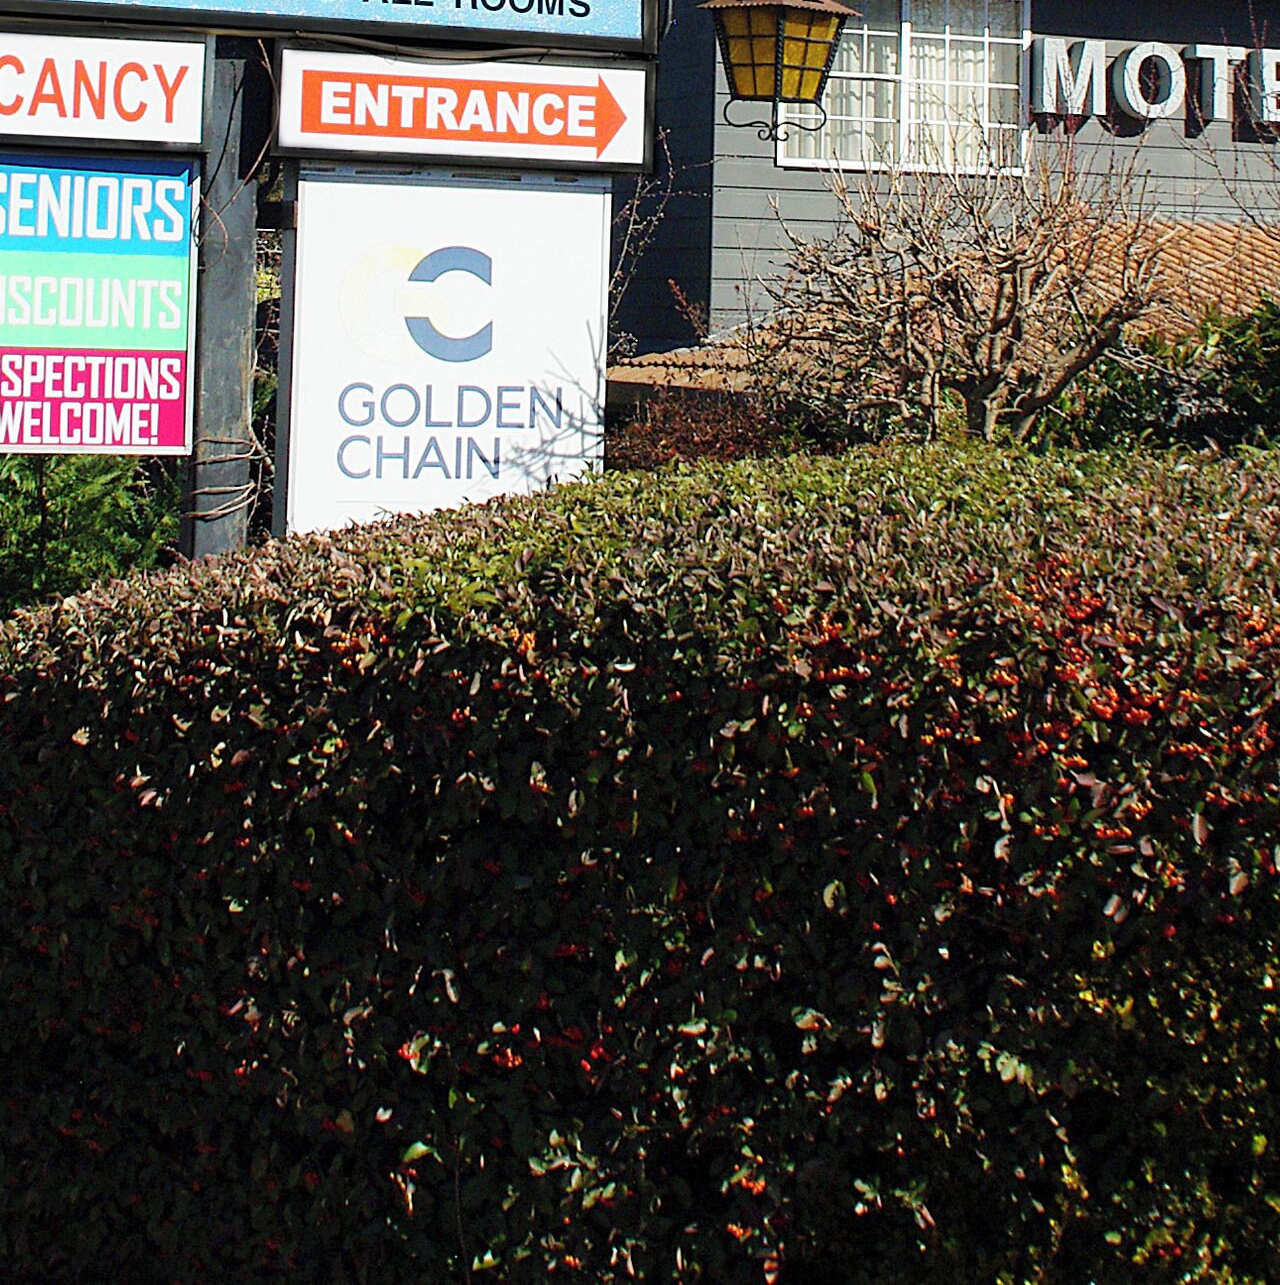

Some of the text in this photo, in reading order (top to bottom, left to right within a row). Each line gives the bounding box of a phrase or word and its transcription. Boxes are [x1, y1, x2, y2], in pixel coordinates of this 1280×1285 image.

[319, 79, 598, 137] ENTRANCE
[338, 381, 563, 429] GOLDEN
[336, 434, 500, 480] CHAIN
